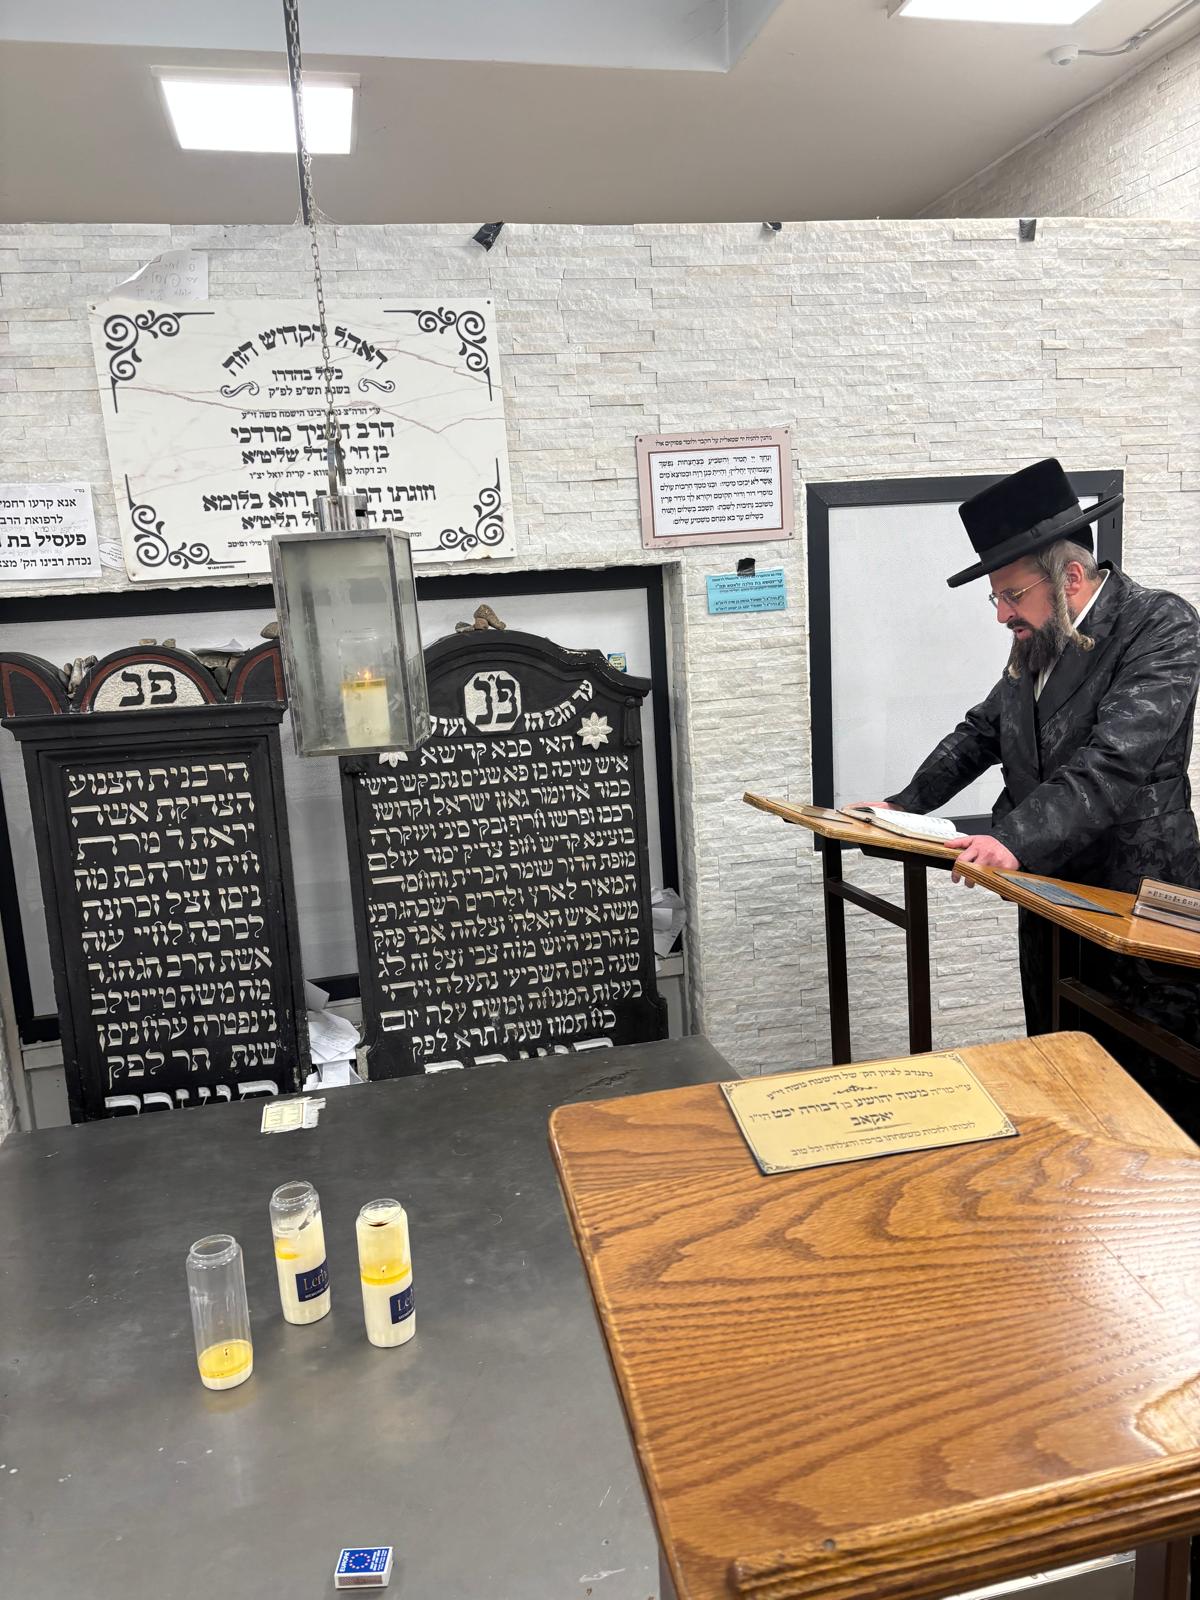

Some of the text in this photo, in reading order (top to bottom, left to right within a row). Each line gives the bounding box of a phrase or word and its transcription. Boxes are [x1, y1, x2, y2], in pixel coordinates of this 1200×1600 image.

[222, 341, 259, 376] הזה
[272, 369, 312, 381] בהדרו
[268, 385, 292, 398] לפ״ק
[231, 422, 394, 444] הרב מרדכי
[242, 447, 299, 464] שליט״א
[373, 446, 389, 462] בן
[267, 470, 283, 478] יואל
[286, 470, 304, 478] קרית
[354, 466, 374, 475] דקהל
[57, 499, 76, 507] אנא
[203, 490, 263, 511] בלומא
[268, 491, 308, 507] רוזא
[387, 484, 436, 502] וזוגתו
[28, 499, 53, 509] קרעו
[25, 514, 63, 524] לרפואת
[241, 512, 298, 529] תליט״א
[382, 509, 404, 522] בת
[8, 532, 86, 547] פעסיל בת
[421, 736, 575, 766] האי סבא קדישא
[532, 762, 548, 781] בן
[595, 755, 628, 773] איש
[68, 762, 249, 797] הרבנית הצנוע
[400, 771, 459, 795] נתבקש
[461, 767, 501, 787] שנים
[594, 779, 630, 798] כבוד
[71, 792, 255, 828] הצדיקת אשה
[434, 794, 490, 815] ישראל
[495, 788, 529, 813] גאון
[439, 820, 470, 839] סיני
[583, 828, 635, 848] בוצינא
[77, 823, 255, 860] יראת מרת
[367, 847, 419, 871] עולם
[424, 846, 458, 863] יסוד
[463, 841, 502, 864] צדיק
[600, 851, 636, 870] מופת
[147, 858, 208, 883] שרה
[510, 859, 553, 879] שומר
[557, 855, 596, 873] הדור
[114, 864, 145, 888] בת
[452, 864, 508, 888] הברית
[581, 874, 636, 898] המאיר
[528, 877, 576, 907] לארץ
[565, 905, 601, 926] איש
[603, 900, 639, 921] משה
[188, 914, 264, 944] לברכה
[166, 946, 272, 978] אשת הרב
[382, 952, 640, 1001] שנה ביום השביעי נתעלה ויהי
[180, 981, 235, 1006] משה
[592, 979, 642, 1003] בעלות
[426, 1001, 466, 1025] עלה
[472, 995, 524, 1019] ומשה
[193, 1011, 259, 1036] נפטרה
[503, 1019, 542, 1042] שנת
[547, 1012, 587, 1036] תמוז
[412, 1028, 447, 1063] לפק
[454, 1026, 497, 1051] תרא
[230, 1042, 277, 1067] שנת
[107, 1049, 165, 1090] לפק
[879, 1068, 901, 1077] לציון
[785, 1081, 807, 1093] משה
[896, 1089, 928, 1100] משה
[799, 1102, 839, 1115] דבורה
[854, 1094, 892, 1107] יהושע
[852, 1112, 894, 1126] יאקאב
